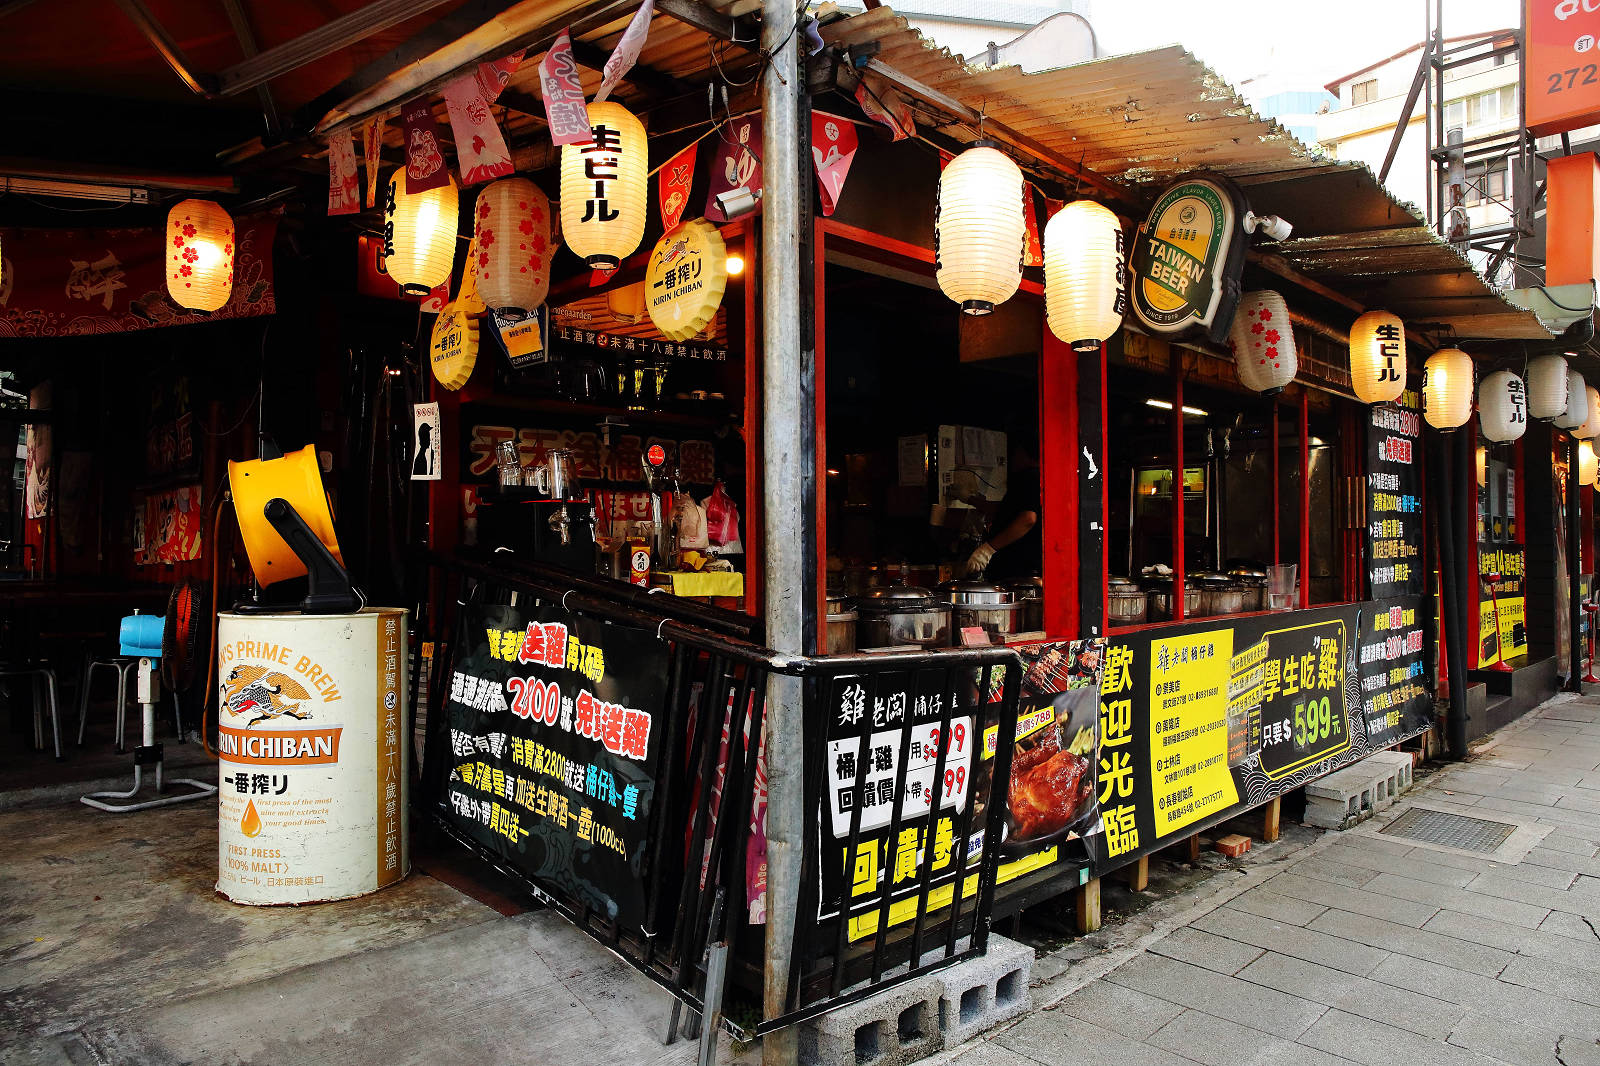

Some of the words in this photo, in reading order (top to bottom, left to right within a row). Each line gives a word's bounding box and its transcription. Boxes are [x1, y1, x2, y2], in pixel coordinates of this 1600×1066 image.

[581, 125, 622, 223] 生ビール
[653, 258, 702, 290] 一番搾り
[1149, 238, 1205, 283] TAIWAN
[1150, 261, 1189, 295] BEER
[653, 293, 672, 307] KIRIN
[673, 280, 703, 299] ICHIBAN
[1145, 309, 1163, 321] SINCE
[434, 331, 462, 351] 一番搾り
[610, 336, 727, 361] 未滿十八歲禁止飲酒
[1375, 324, 1401, 383] 生ビール
[1507, 379, 1525, 424] 生ビール
[470, 425, 714, 484] 天天送桶雞
[385, 618, 397, 689] 禁止酒駕
[237, 640, 293, 667] PRIME
[294, 654, 342, 704] BREW
[241, 735, 333, 760] ICHIBAN
[1099, 644, 1139, 859] 歡迎光臨
[1163, 753, 1181, 770] 士林店
[225, 772, 289, 796] 一番搾り
[385, 712, 397, 871] 未滿十八歲禁止飲酒
[924, 766, 966, 805] $99
[282, 819, 302, 827] good
[448, 789, 529, 843] 仔雞外帶買四送一
[228, 844, 248, 856] FIRST
[251, 849, 281, 858] PRESS
